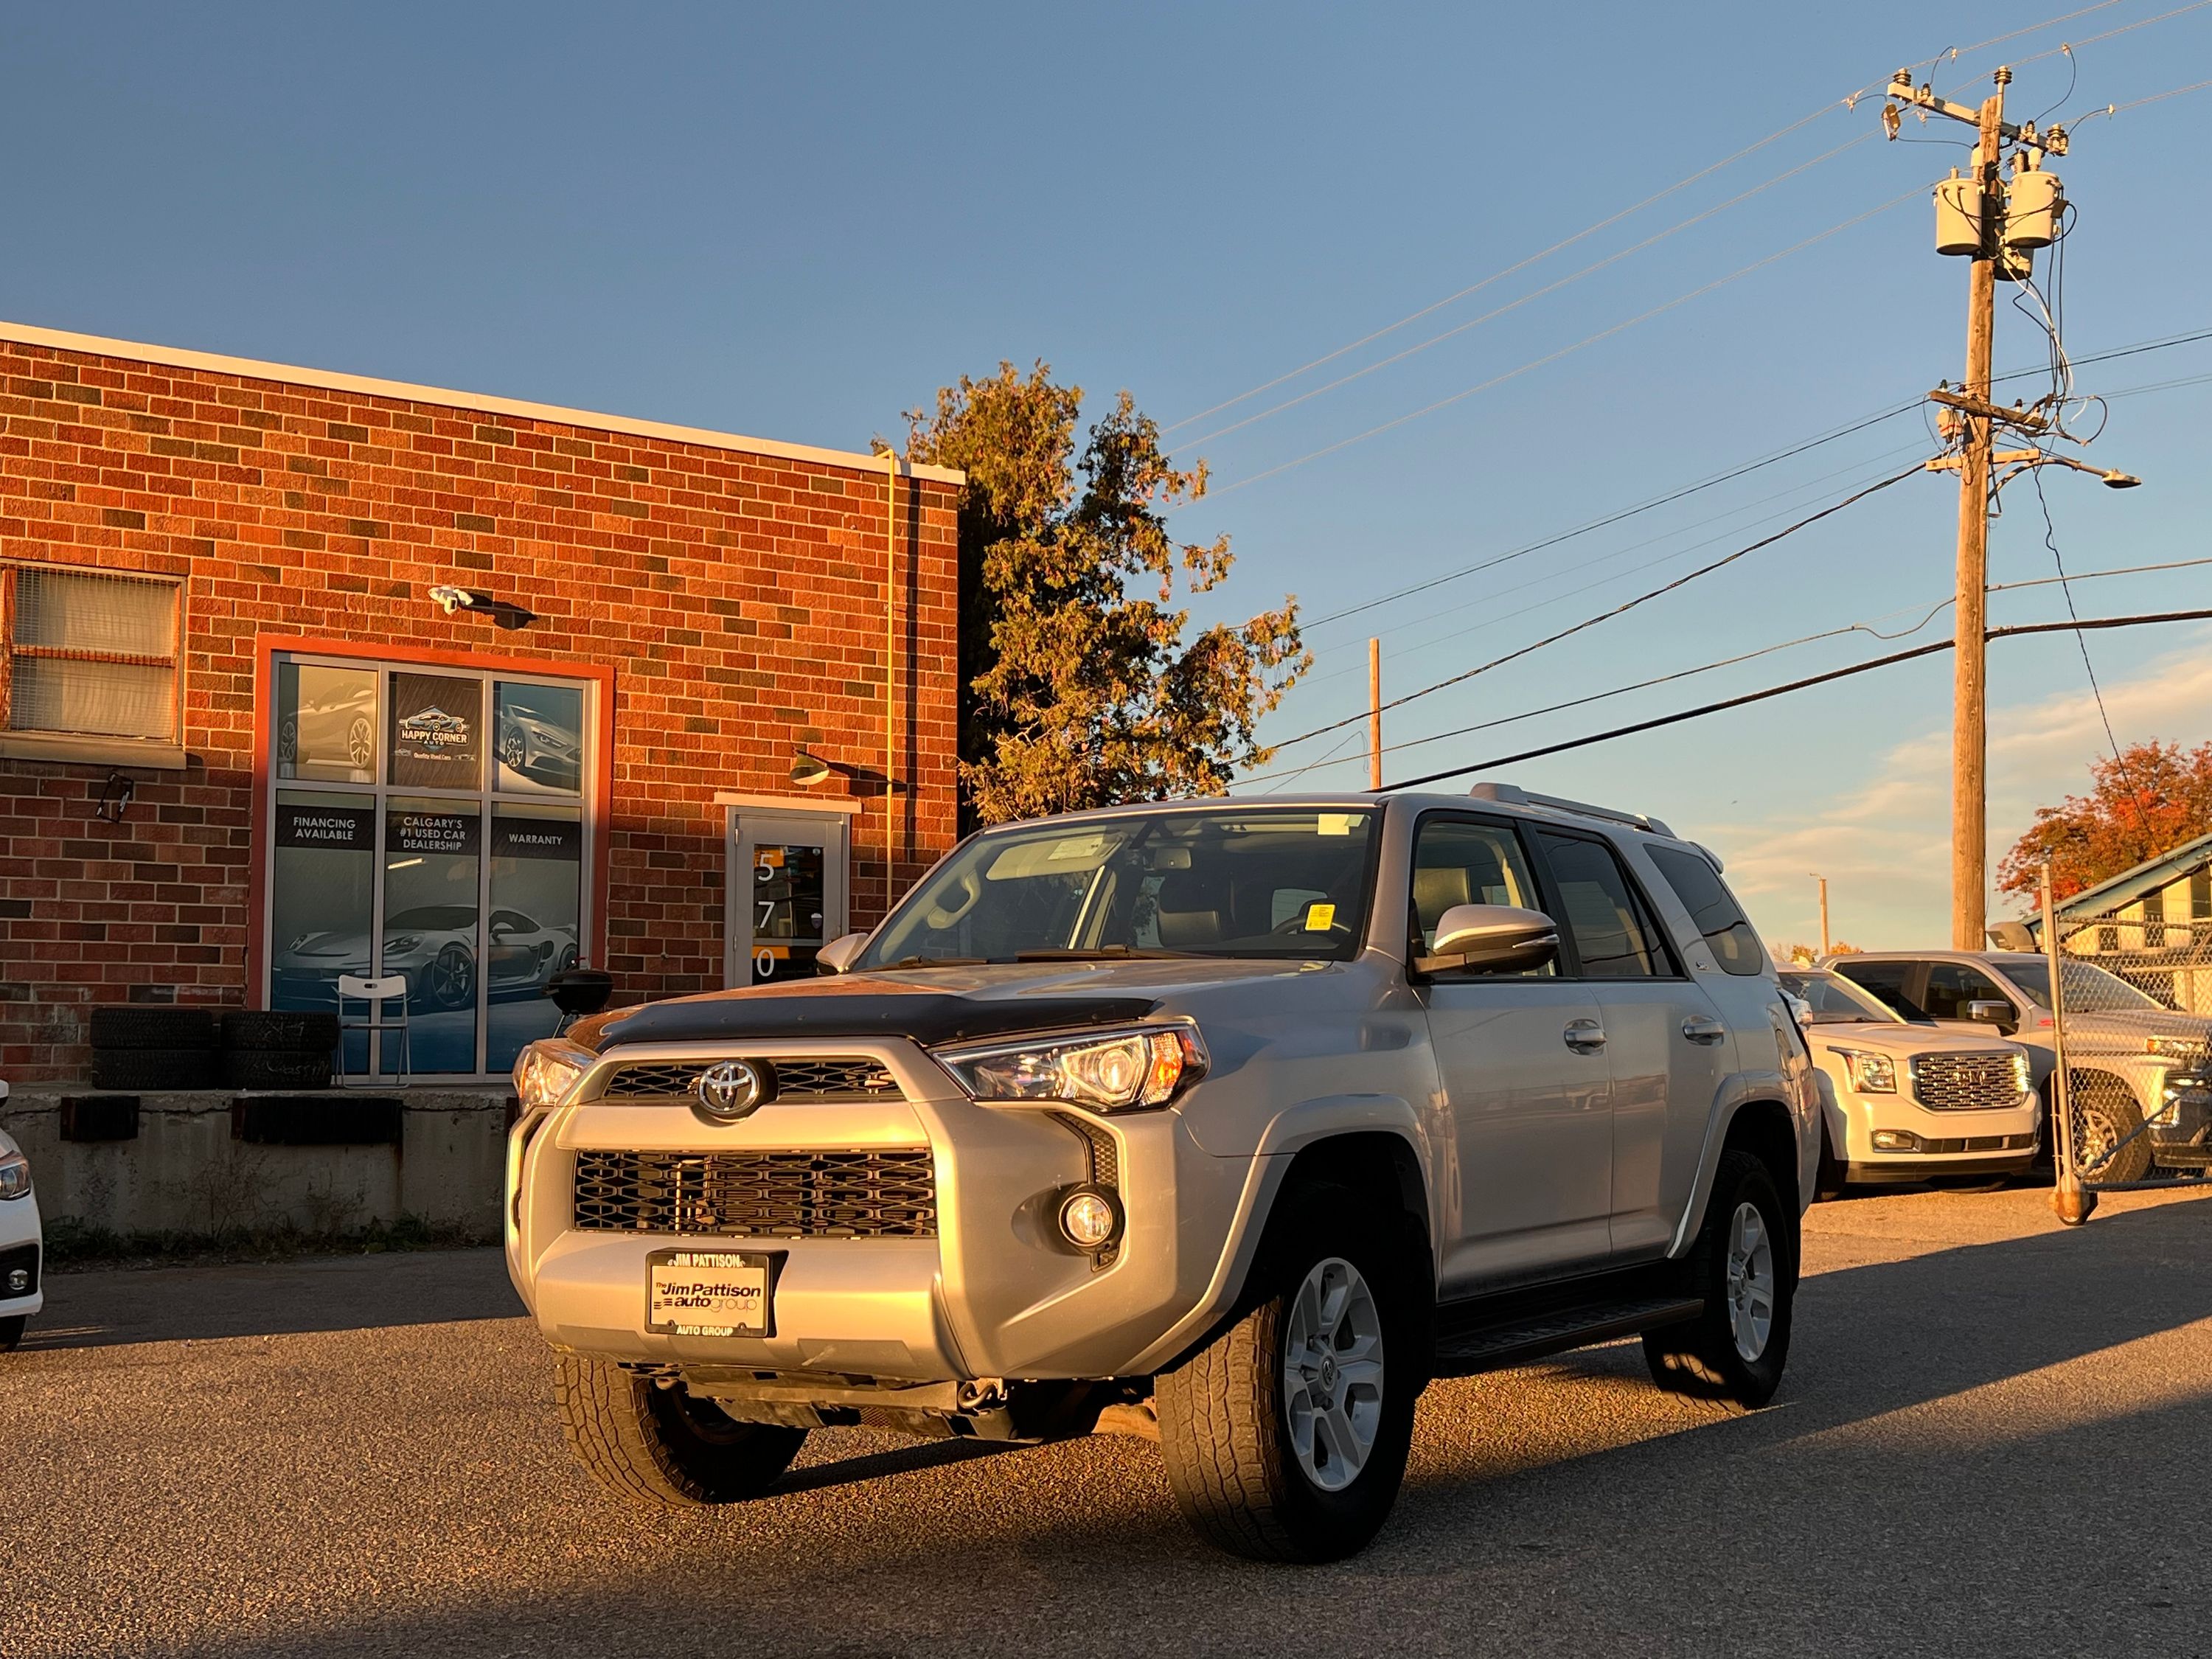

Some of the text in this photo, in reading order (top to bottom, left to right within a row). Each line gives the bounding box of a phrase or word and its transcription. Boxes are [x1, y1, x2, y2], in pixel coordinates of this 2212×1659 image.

[401, 729, 467, 743] HAPPY CORNER
[293, 816, 356, 829] FINANCING
[403, 816, 463, 829] CALGARY'S
[295, 828, 353, 841] AVAILABLE
[400, 827, 466, 841] #1 USED CAR
[509, 833, 563, 846] WARRANTY
[403, 839, 462, 851] DEALERSHIP
[674, 1253, 740, 1267] JIM PATTISON
[676, 1325, 734, 1337] AUTO GROUP
